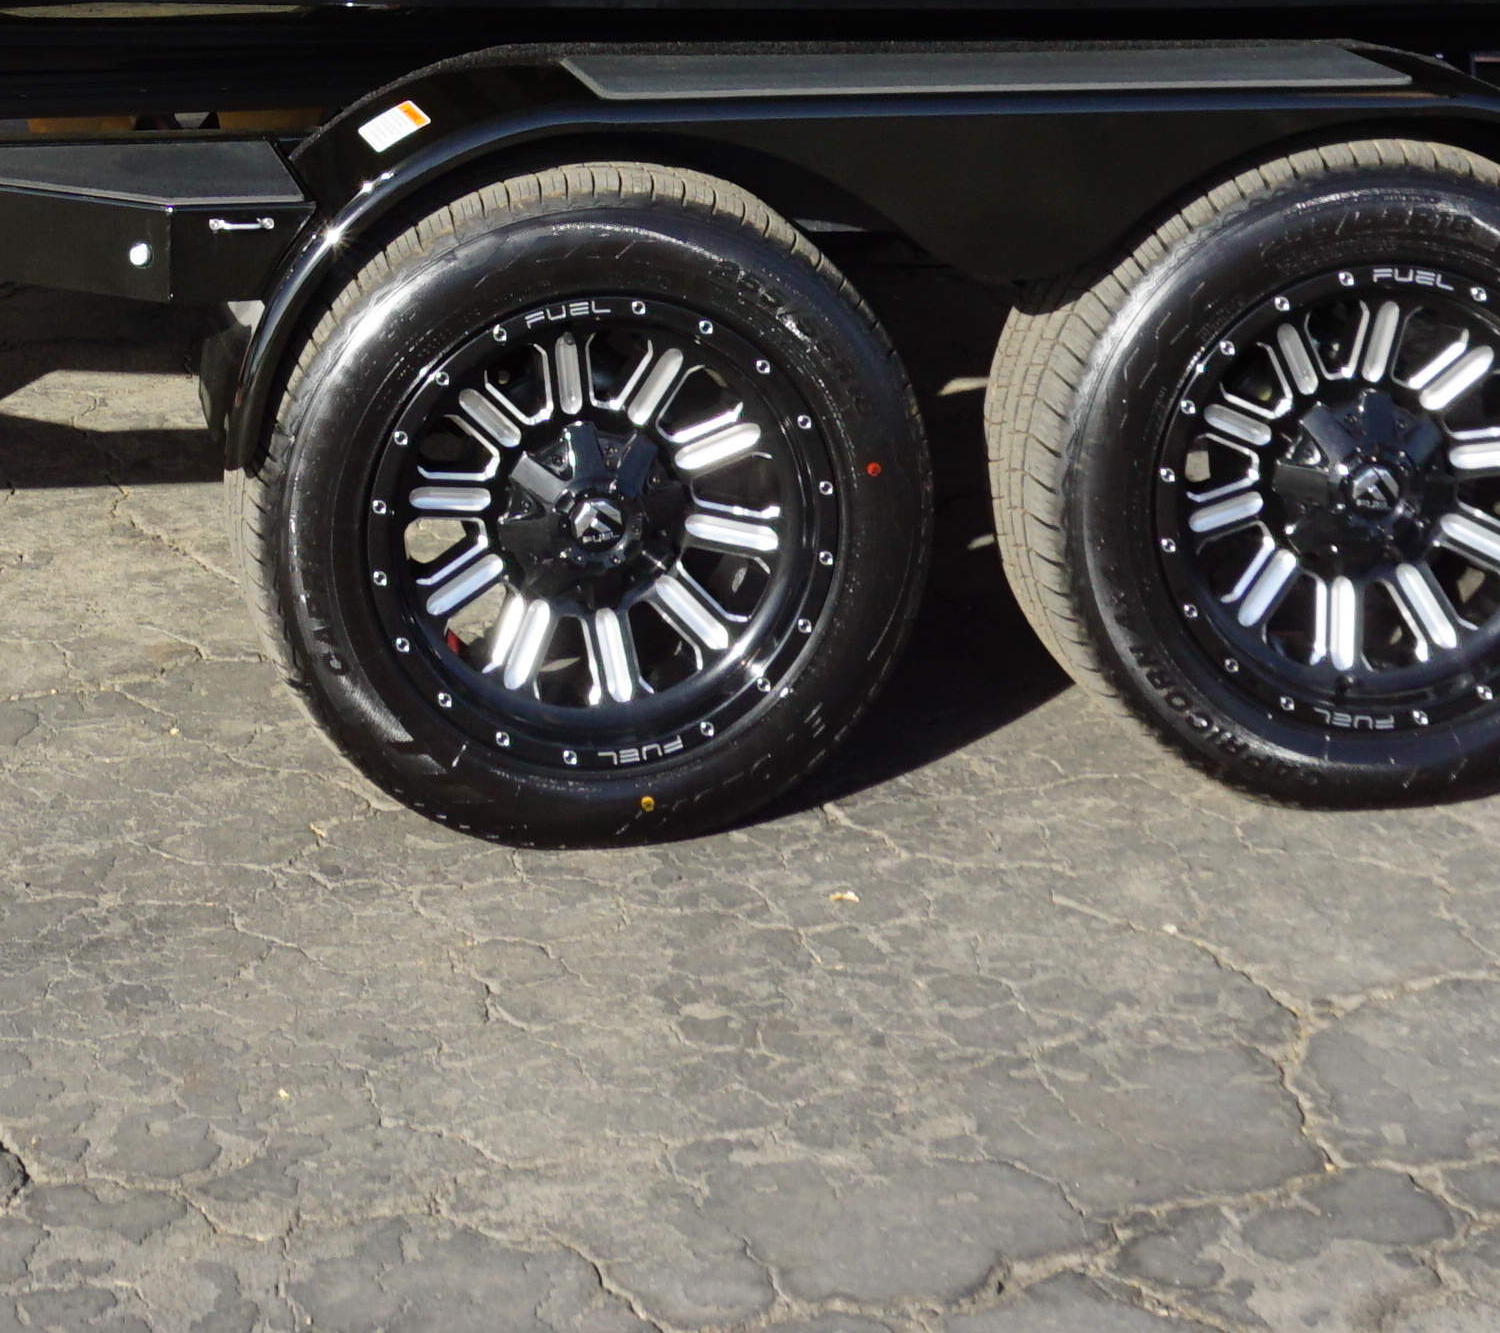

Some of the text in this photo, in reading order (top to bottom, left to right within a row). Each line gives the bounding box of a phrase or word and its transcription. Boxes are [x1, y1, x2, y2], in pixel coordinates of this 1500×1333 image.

[1372, 267, 1455, 291] FUEL
[524, 299, 612, 329] FUEL
[1312, 706, 1395, 730] FUEL
[597, 734, 684, 766] FUEL
